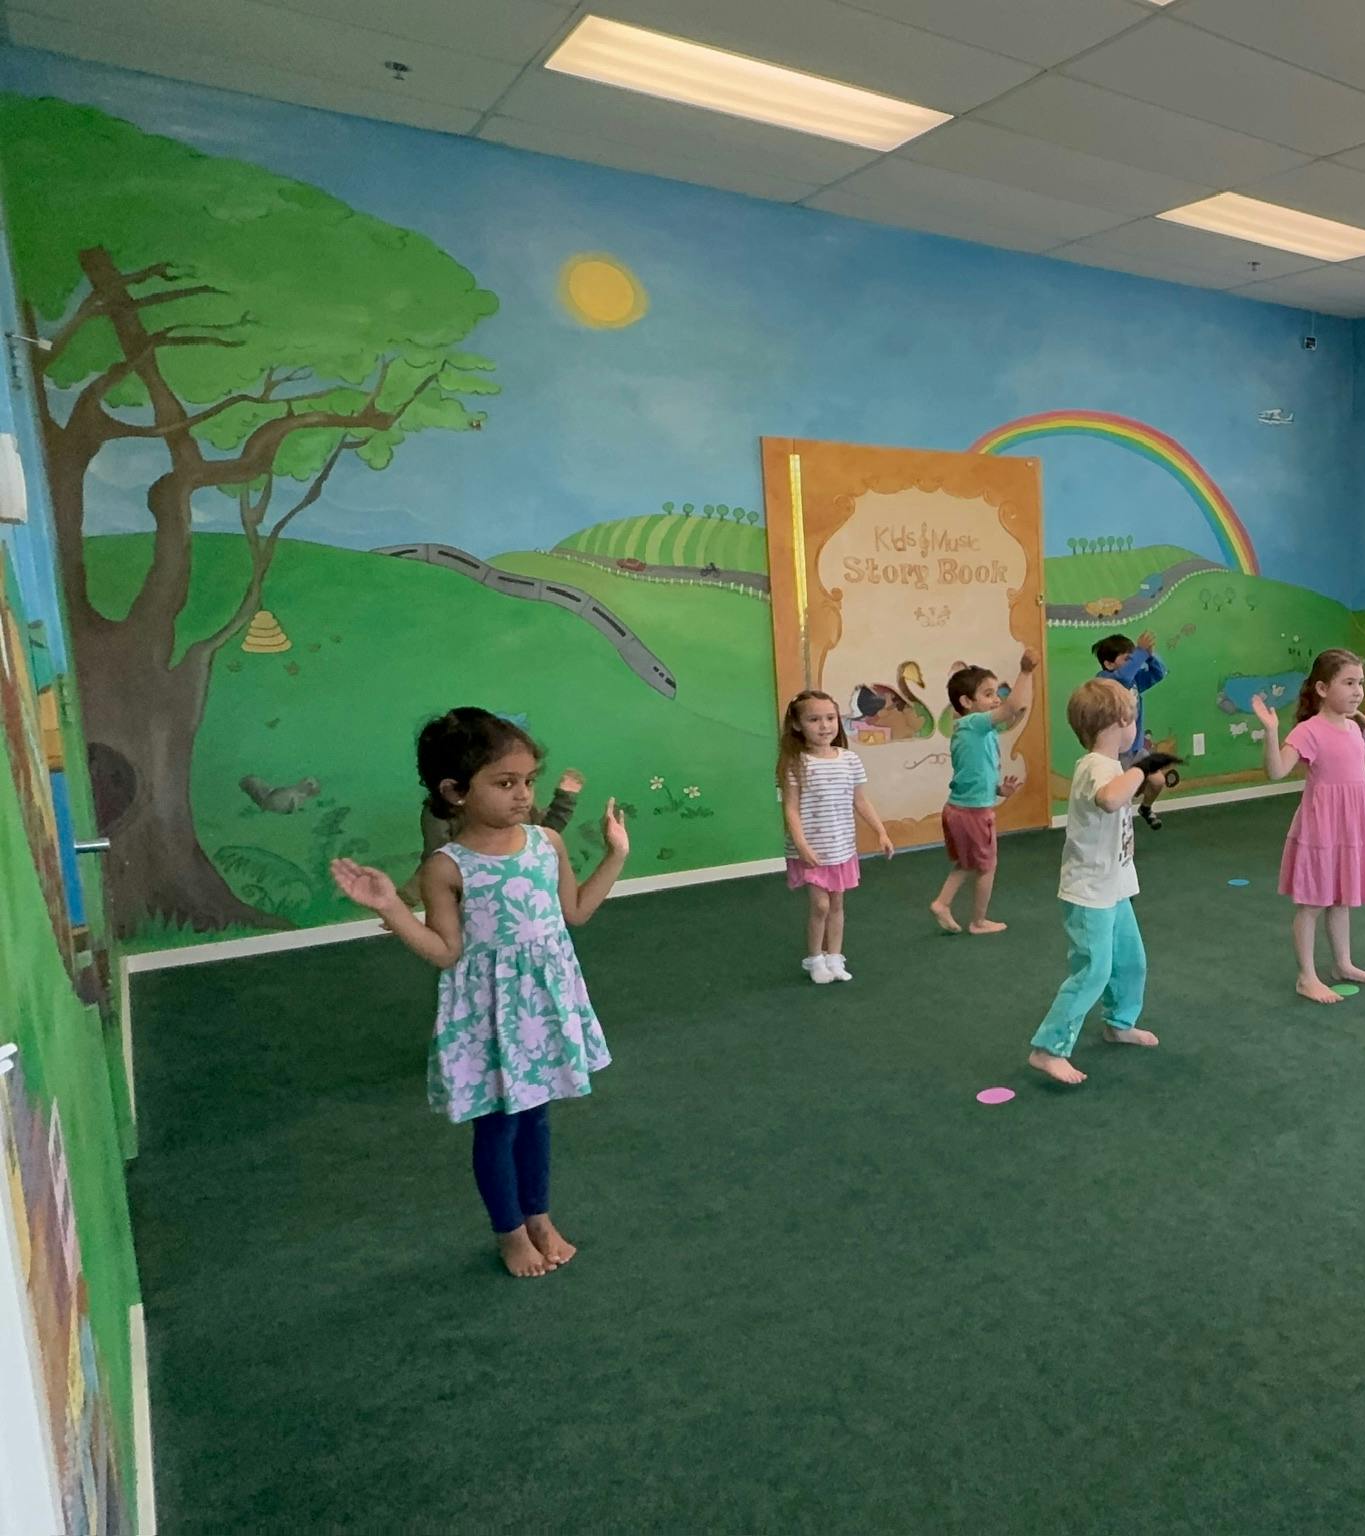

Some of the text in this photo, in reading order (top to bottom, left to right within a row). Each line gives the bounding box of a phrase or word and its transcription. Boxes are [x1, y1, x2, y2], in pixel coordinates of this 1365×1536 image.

[873, 523, 982, 552] Kids Music
[842, 556, 1008, 590] Story Book
